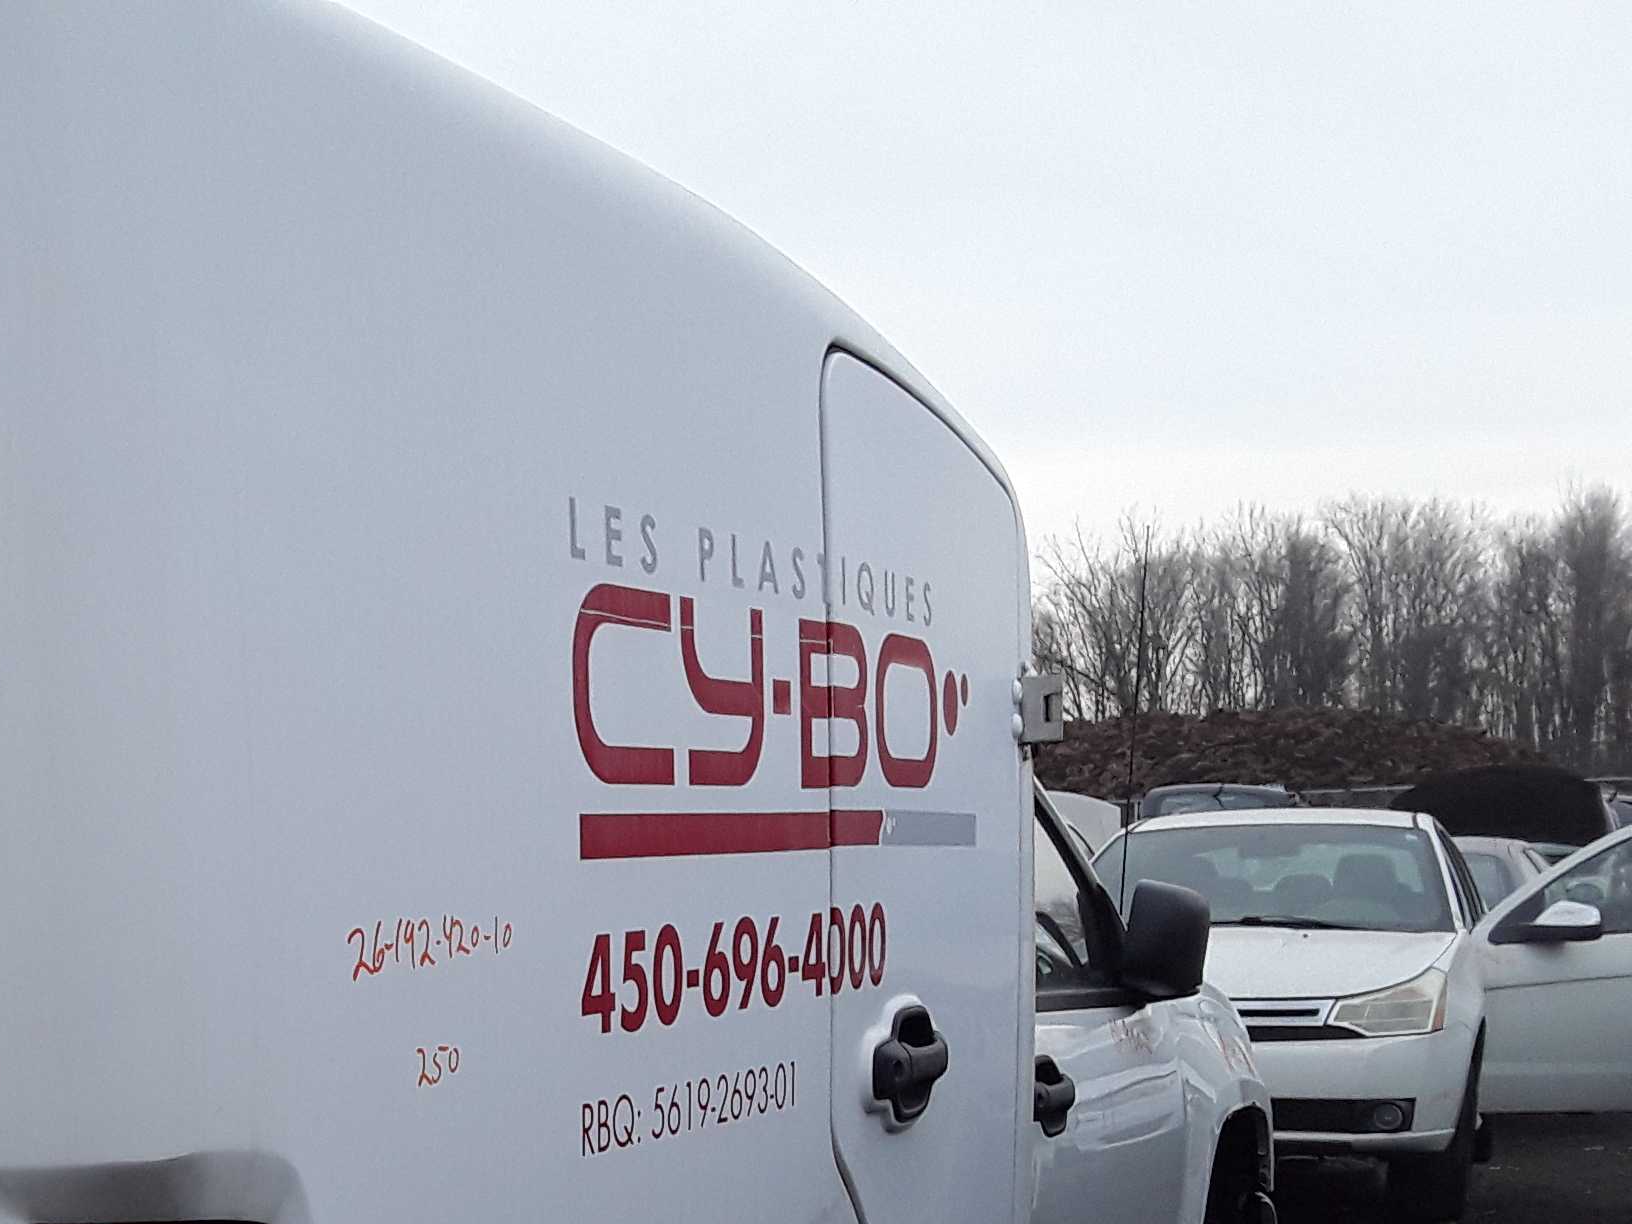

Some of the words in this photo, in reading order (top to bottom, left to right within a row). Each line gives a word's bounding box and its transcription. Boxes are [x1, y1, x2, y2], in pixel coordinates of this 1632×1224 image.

[568, 496, 658, 574] LES
[580, 901, 886, 1034] 450-696-4000
[416, 1045, 460, 1088] 250
[581, 1093, 642, 1157] RBQ:
[651, 1060, 796, 1140] 5619-2693-01
